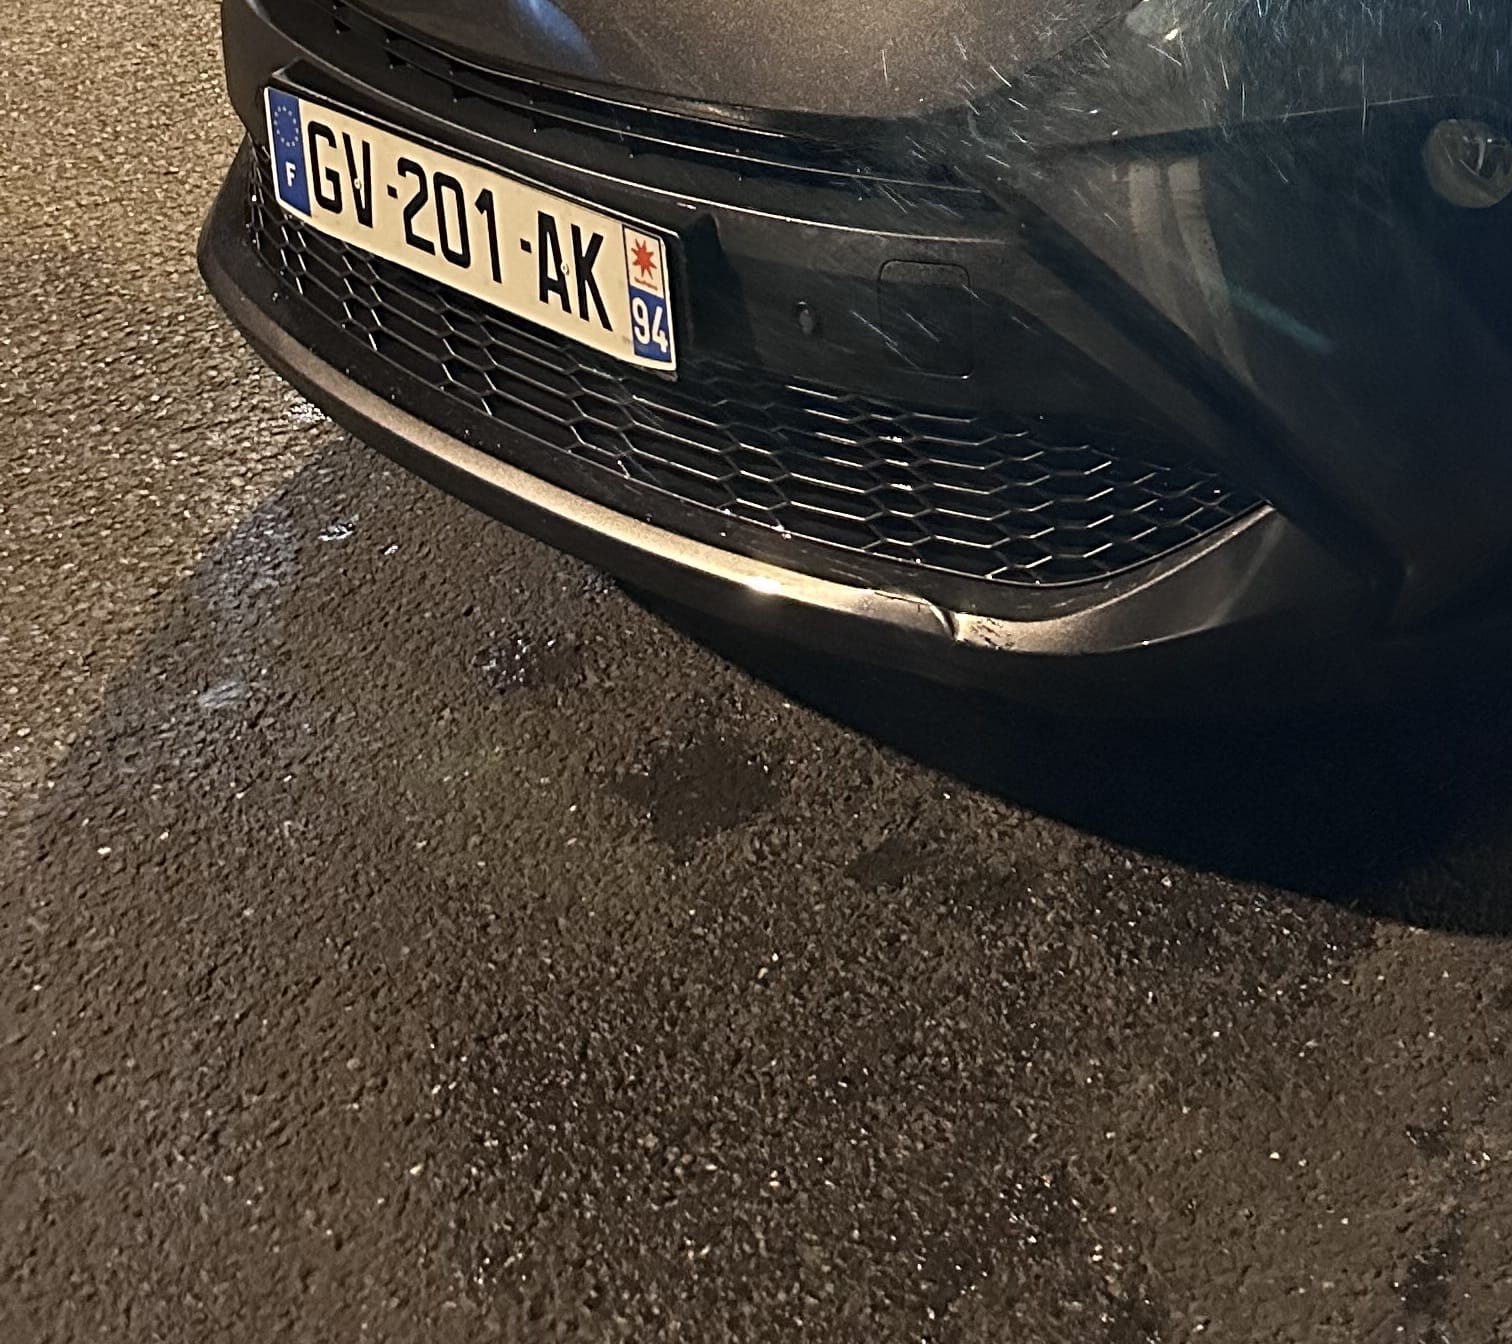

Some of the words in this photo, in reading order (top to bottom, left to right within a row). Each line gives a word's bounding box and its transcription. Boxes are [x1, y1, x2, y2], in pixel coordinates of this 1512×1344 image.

[286, 162, 295, 187] F
[307, 120, 614, 332] GV-201-AK
[632, 296, 668, 353] 94
